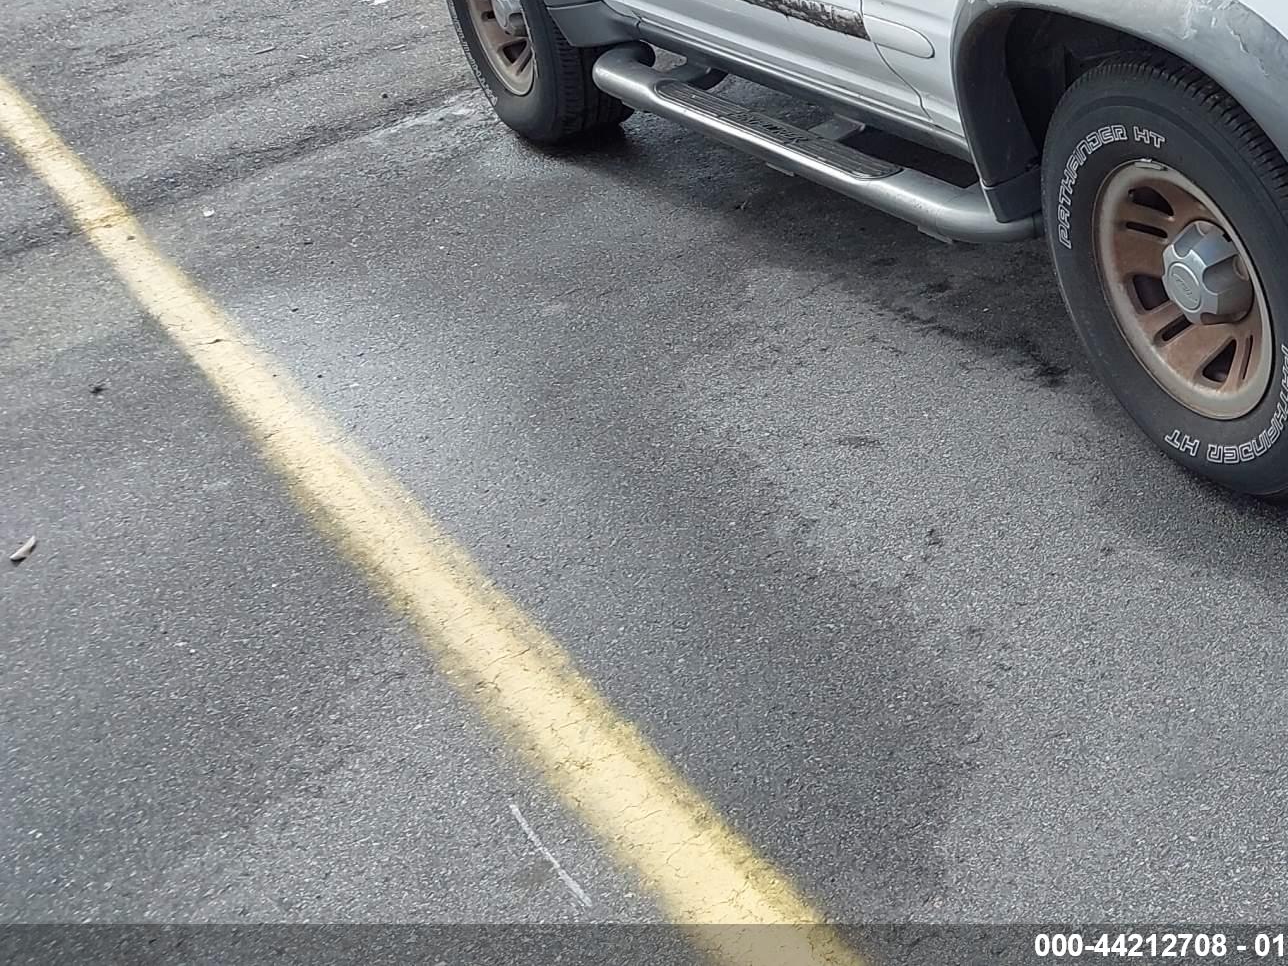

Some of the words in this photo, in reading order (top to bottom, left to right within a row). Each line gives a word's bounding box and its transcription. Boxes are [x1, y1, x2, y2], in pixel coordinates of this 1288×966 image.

[1057, 124, 1128, 250] PATHFINDER
[1132, 125, 1166, 149] HT
[1164, 429, 1200, 457] HT
